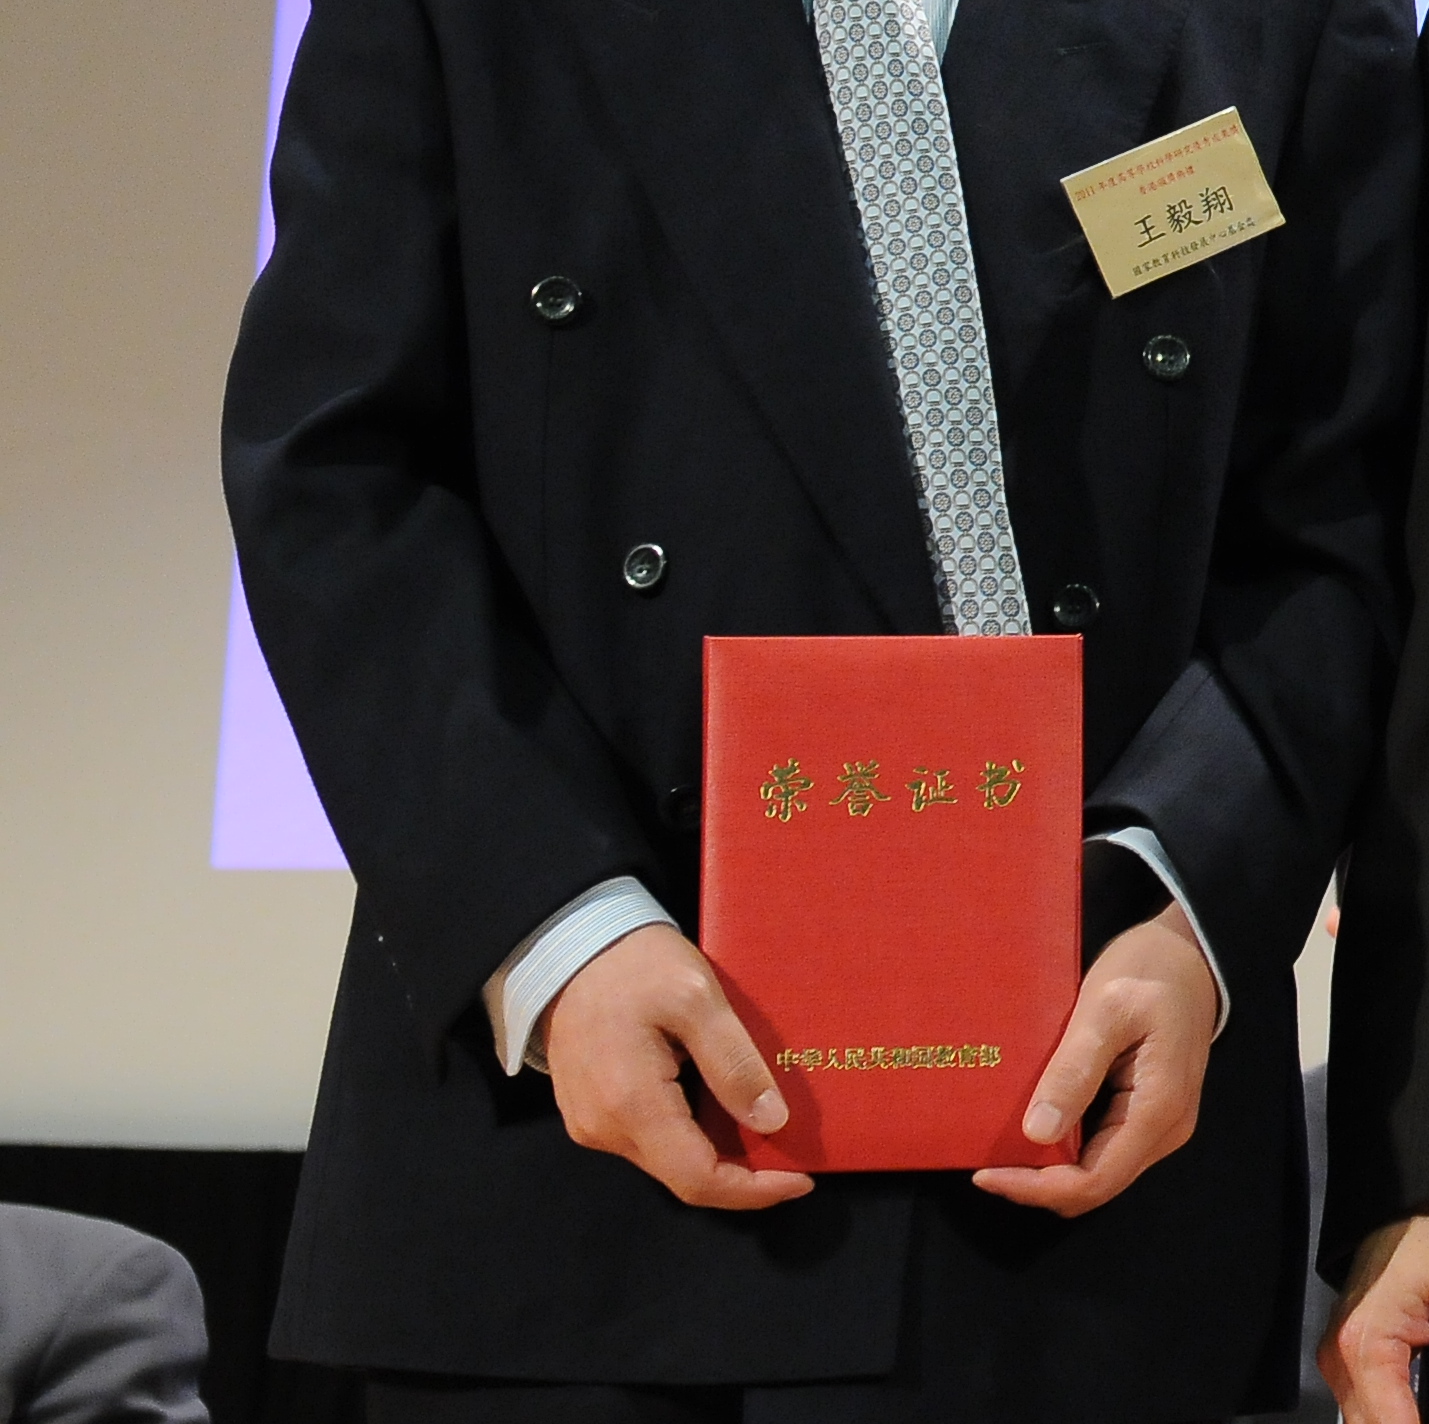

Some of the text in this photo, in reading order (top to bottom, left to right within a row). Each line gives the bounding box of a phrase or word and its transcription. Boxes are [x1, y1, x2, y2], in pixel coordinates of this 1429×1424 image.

[1133, 185, 1235, 249] 王毅翔
[758, 757, 1026, 823] 荣誉证书
